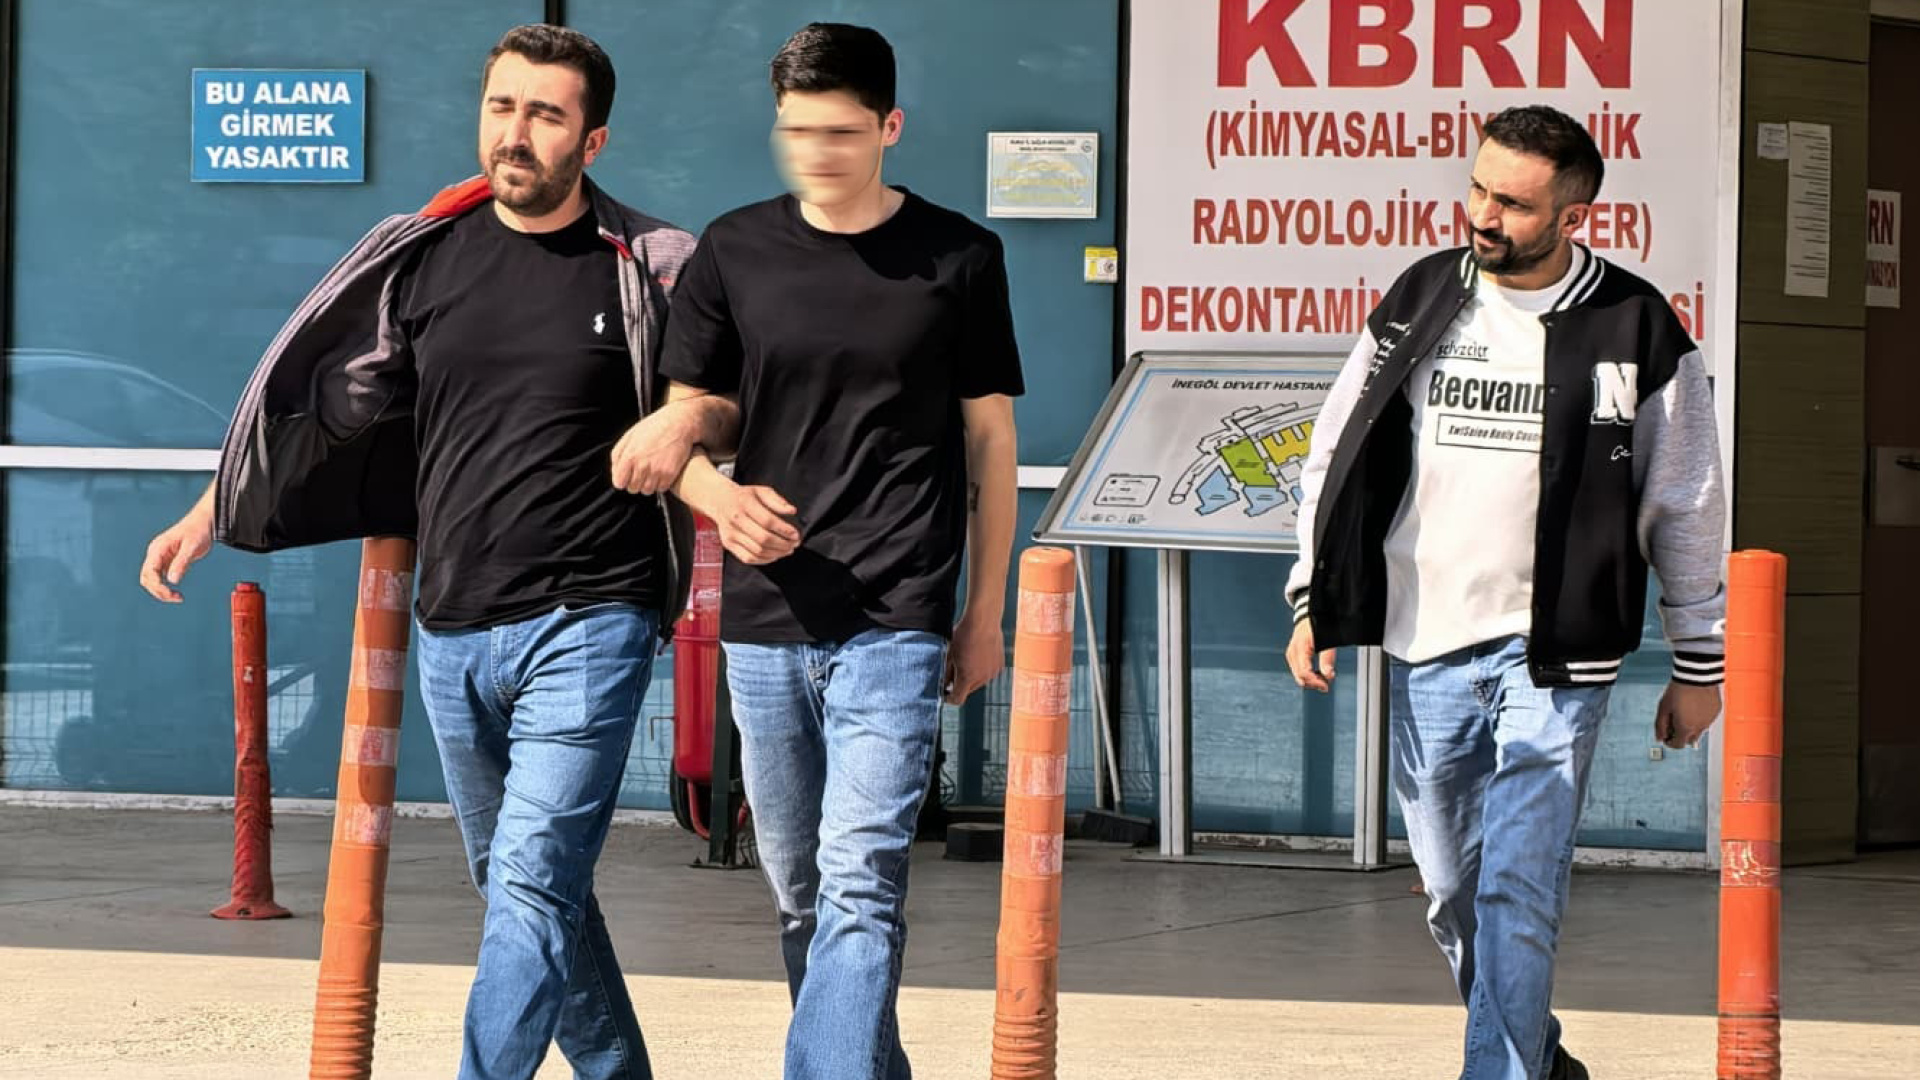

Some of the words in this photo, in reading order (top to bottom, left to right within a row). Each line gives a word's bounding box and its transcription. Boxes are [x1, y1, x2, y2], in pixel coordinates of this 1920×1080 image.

[1217, 0, 1633, 88] KBRN
[206, 82, 245, 104] BU
[253, 82, 351, 104] ALANA
[220, 109, 335, 136] GİRMEK
[205, 146, 350, 168] YASAKTIR
[1171, 378, 1218, 389] İNEGÖL
[1223, 380, 1270, 390] DEVLET
